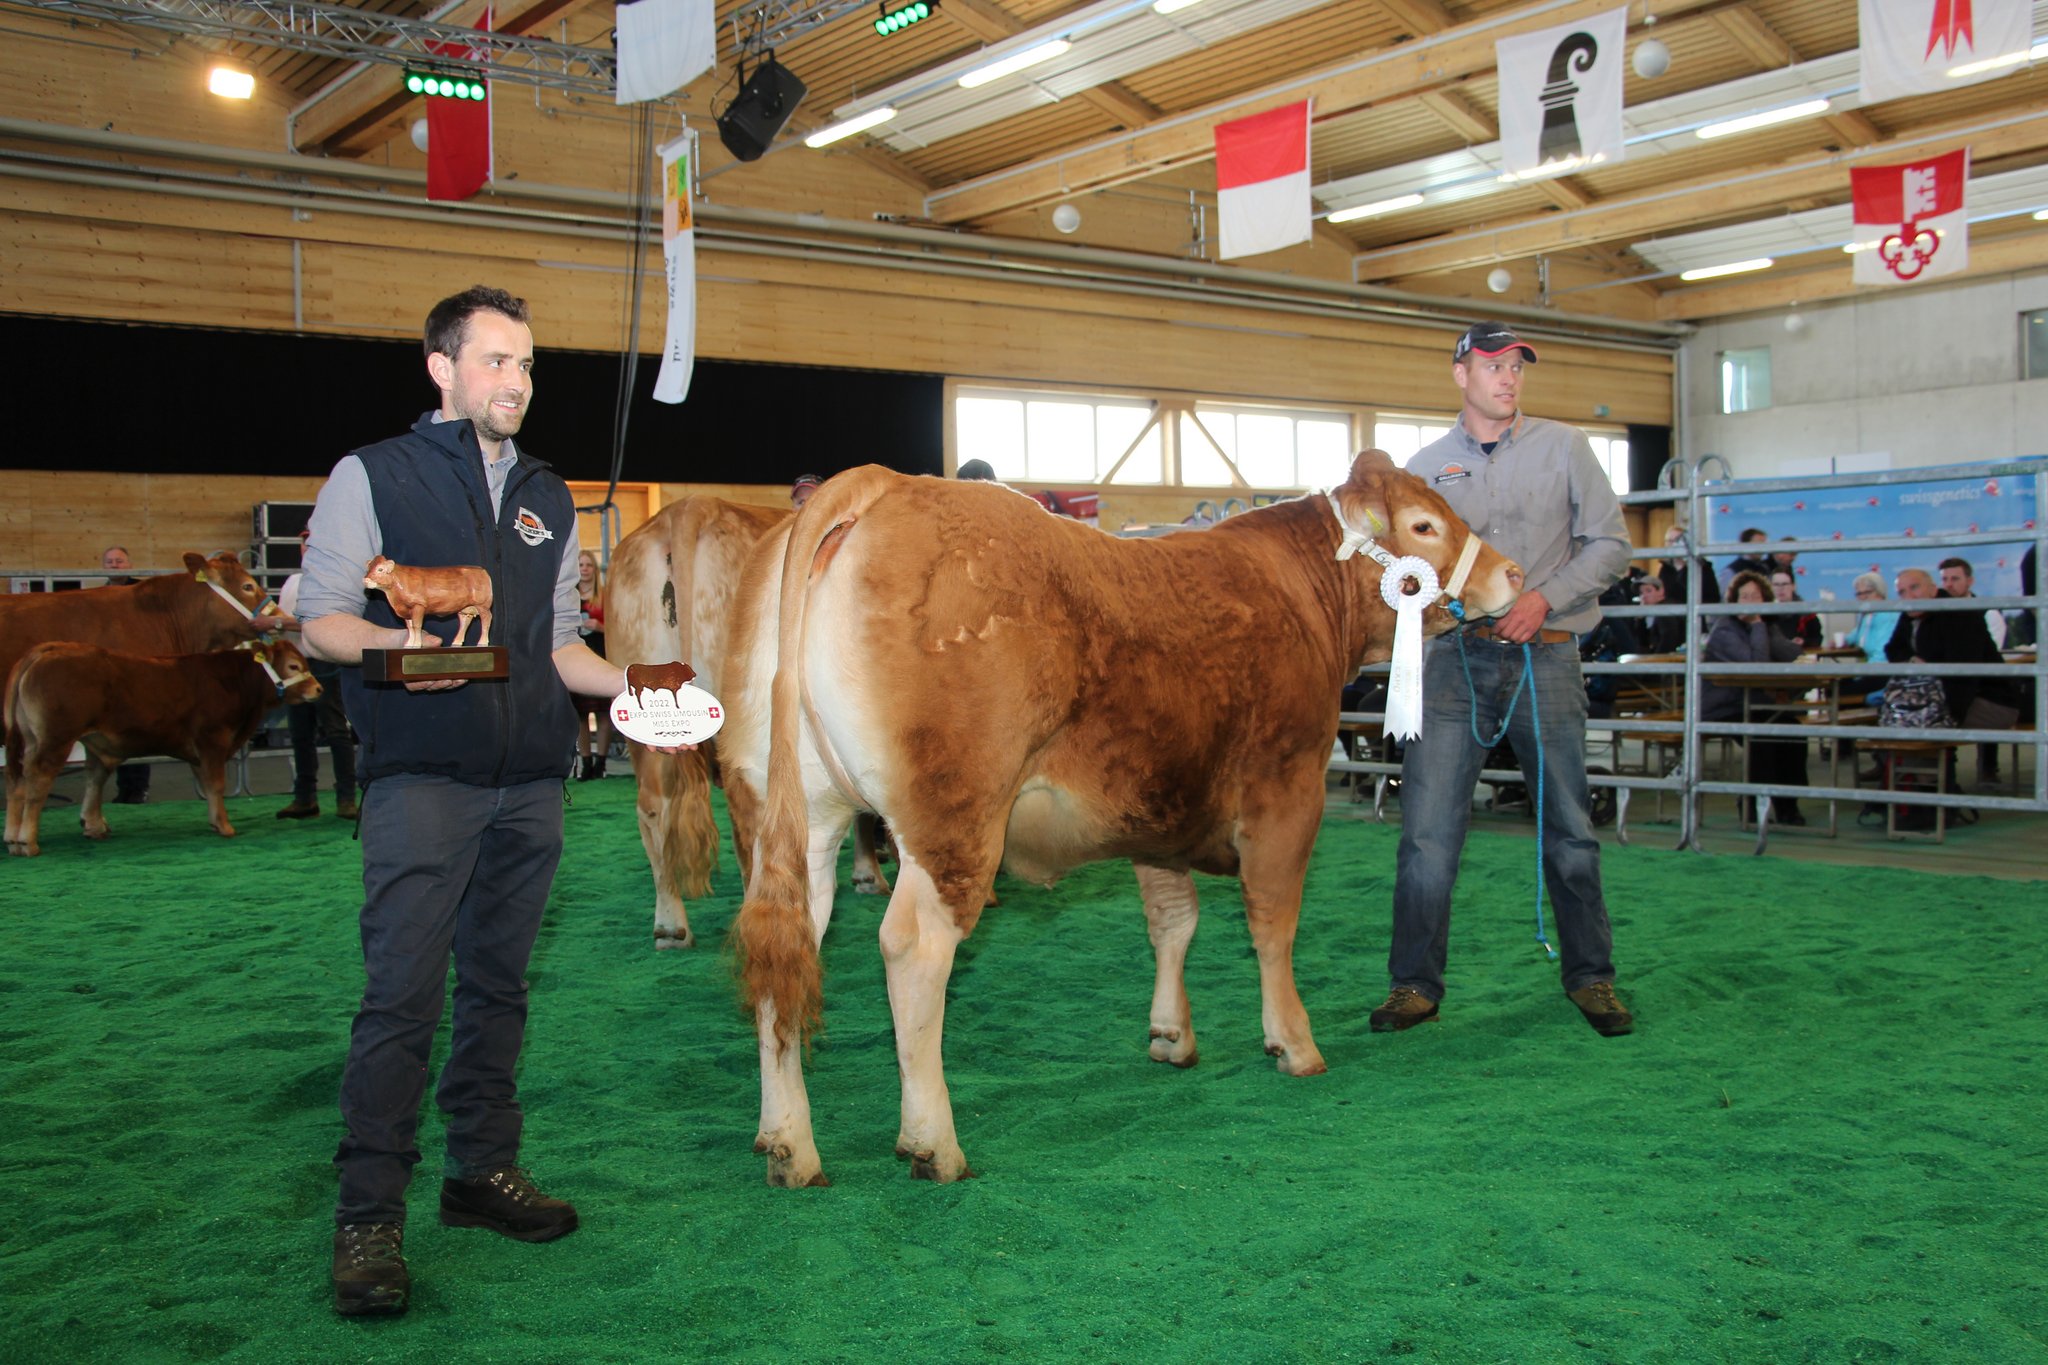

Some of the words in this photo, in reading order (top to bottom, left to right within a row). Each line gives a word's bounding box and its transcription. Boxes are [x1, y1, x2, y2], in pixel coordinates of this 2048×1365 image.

[649, 699, 670, 708] 2022
[629, 711, 648, 719] EXPO
[649, 710, 672, 718] SWISS
[673, 709, 709, 717] LIMOUSIN
[652, 720, 669, 728] MISS
[671, 719, 690, 727] EXPO
